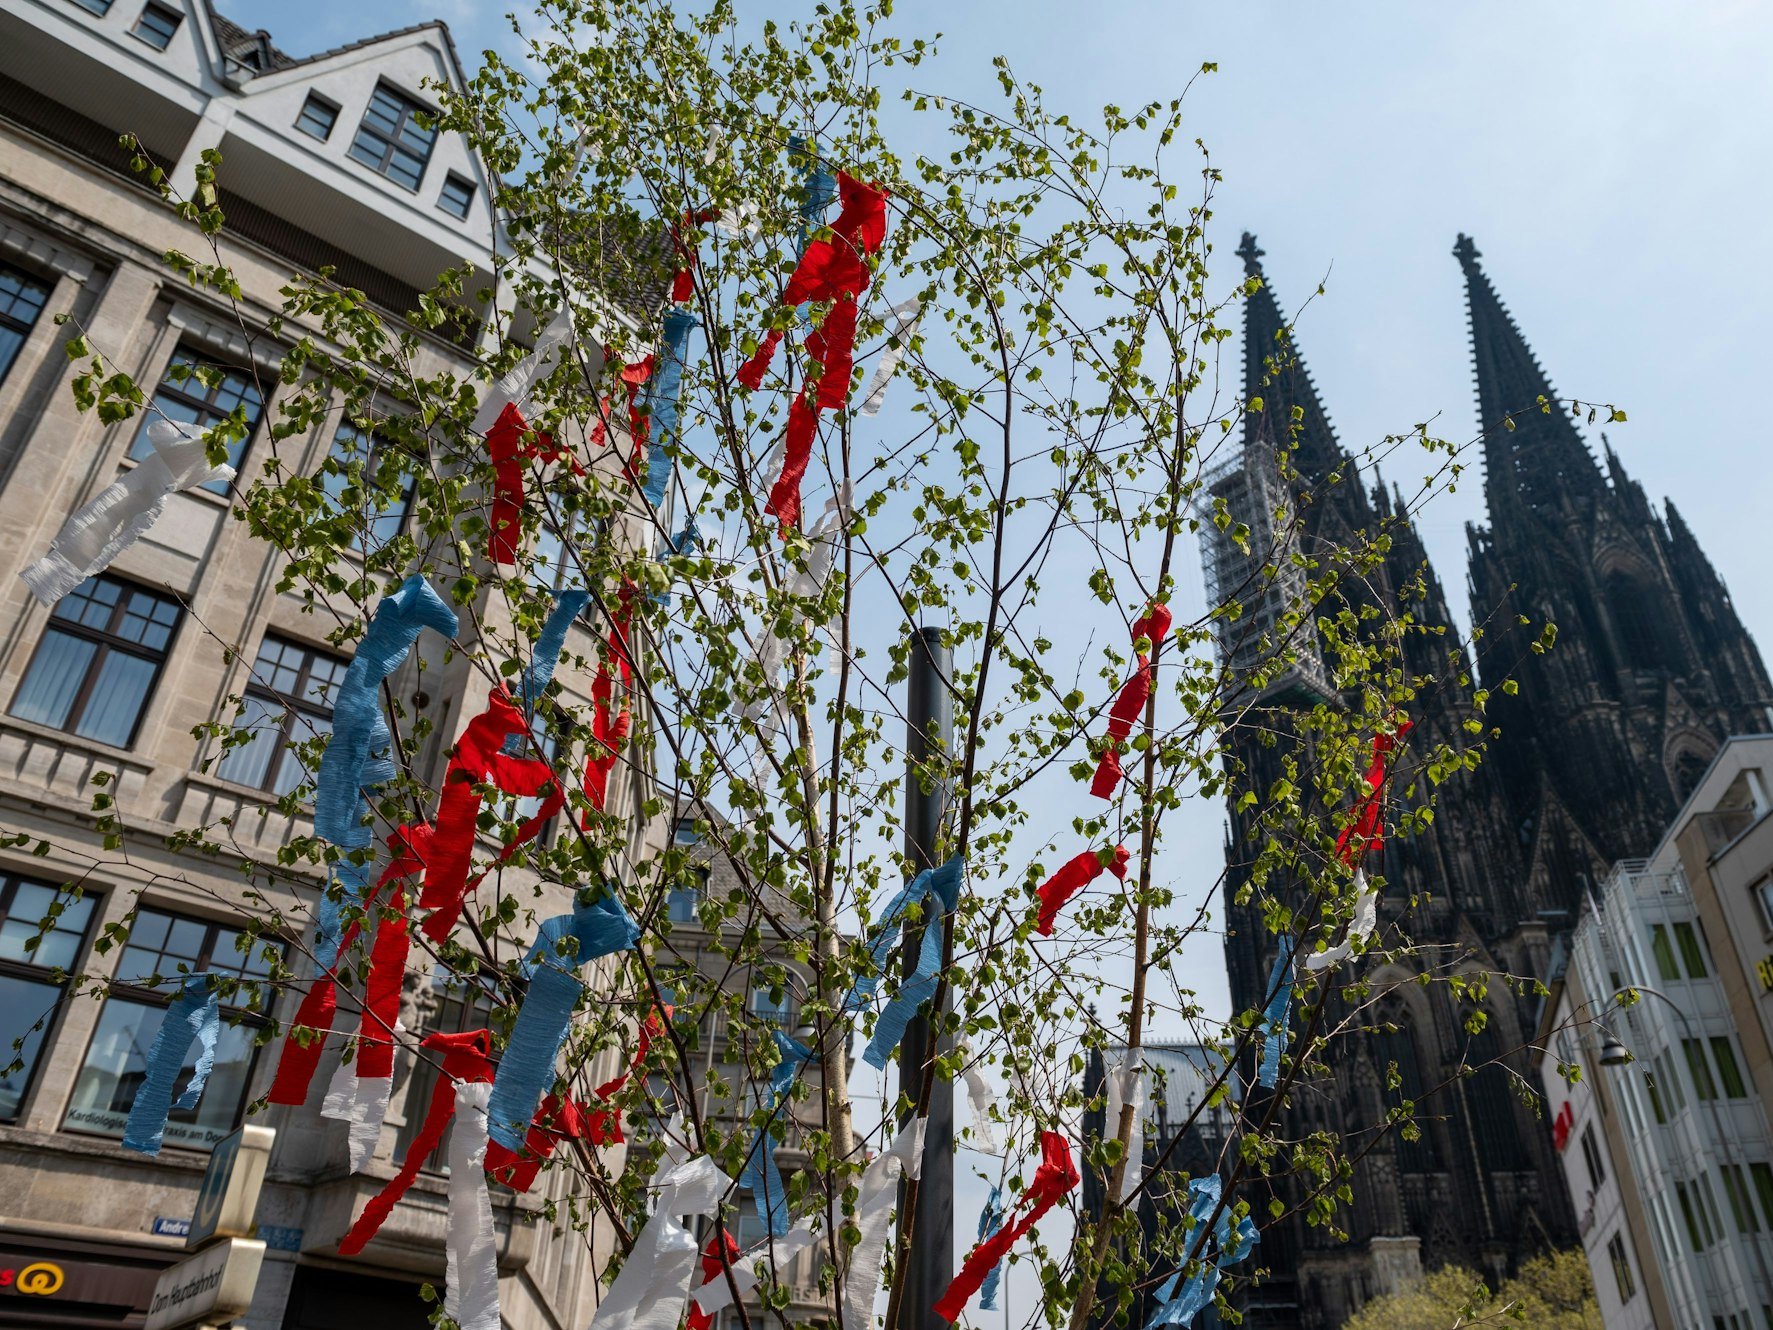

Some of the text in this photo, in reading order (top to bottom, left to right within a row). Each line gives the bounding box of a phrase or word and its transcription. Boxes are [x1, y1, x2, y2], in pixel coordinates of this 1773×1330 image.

[67, 1109, 223, 1143] Kardiologisc raxis am Do
[200, 1143, 236, 1228] U
[151, 1263, 224, 1315] Dom Hauptbahnhof
